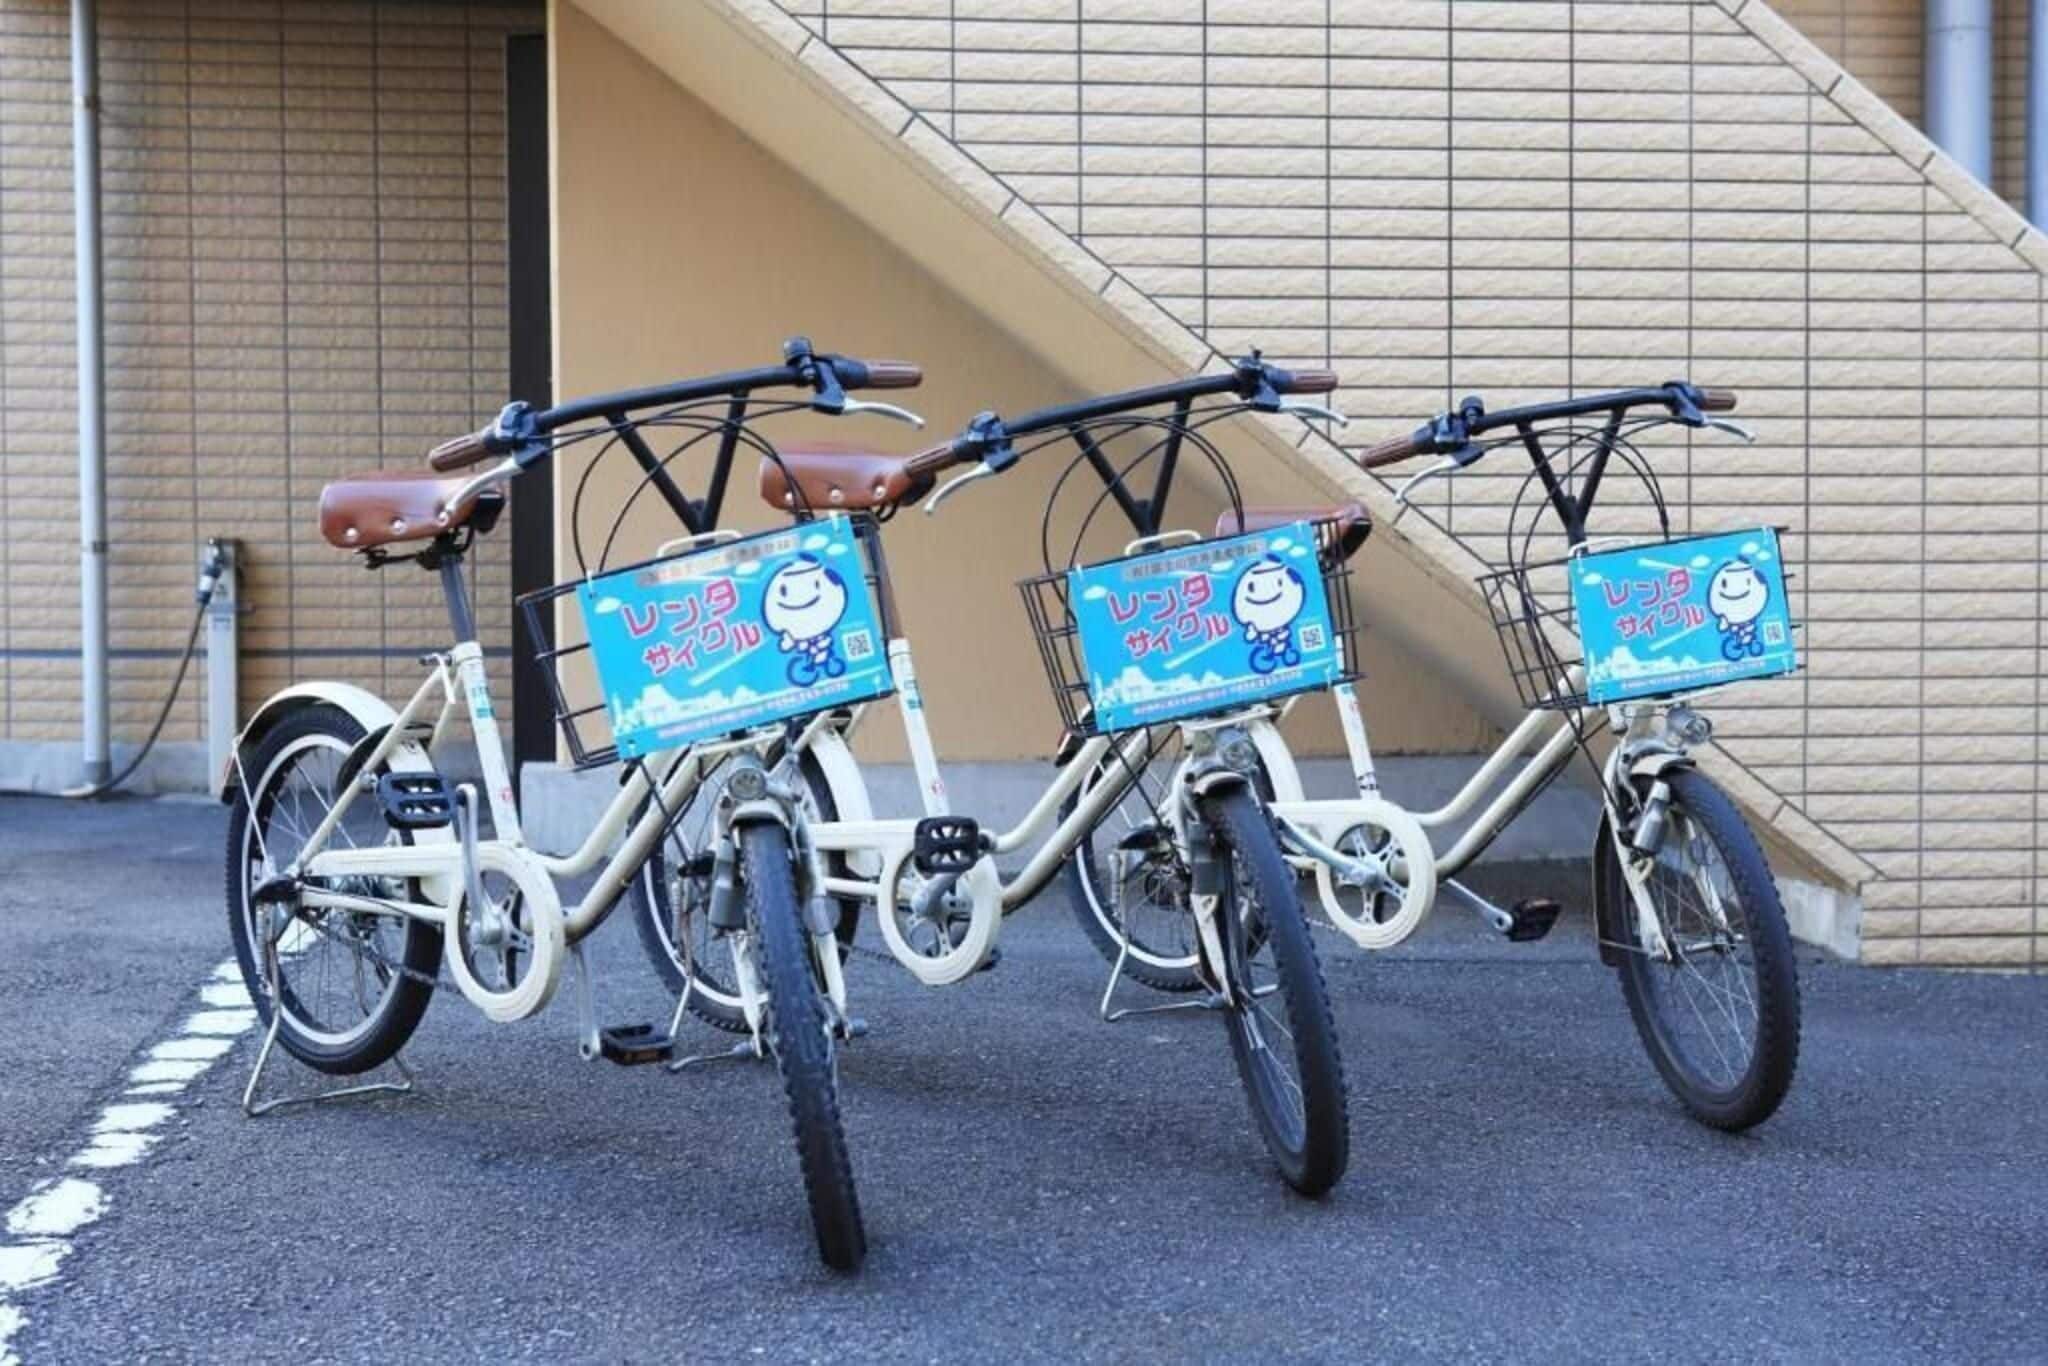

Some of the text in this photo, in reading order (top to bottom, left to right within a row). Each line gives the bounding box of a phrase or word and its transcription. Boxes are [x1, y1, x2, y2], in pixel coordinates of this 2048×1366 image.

[622, 576, 739, 636] レンタ
[1109, 573, 1212, 623] レンタ
[1603, 567, 1691, 608] レンタ
[1125, 610, 1231, 658] サイクル
[1616, 600, 1705, 639] サイクル
[644, 618, 761, 676] サイクル
